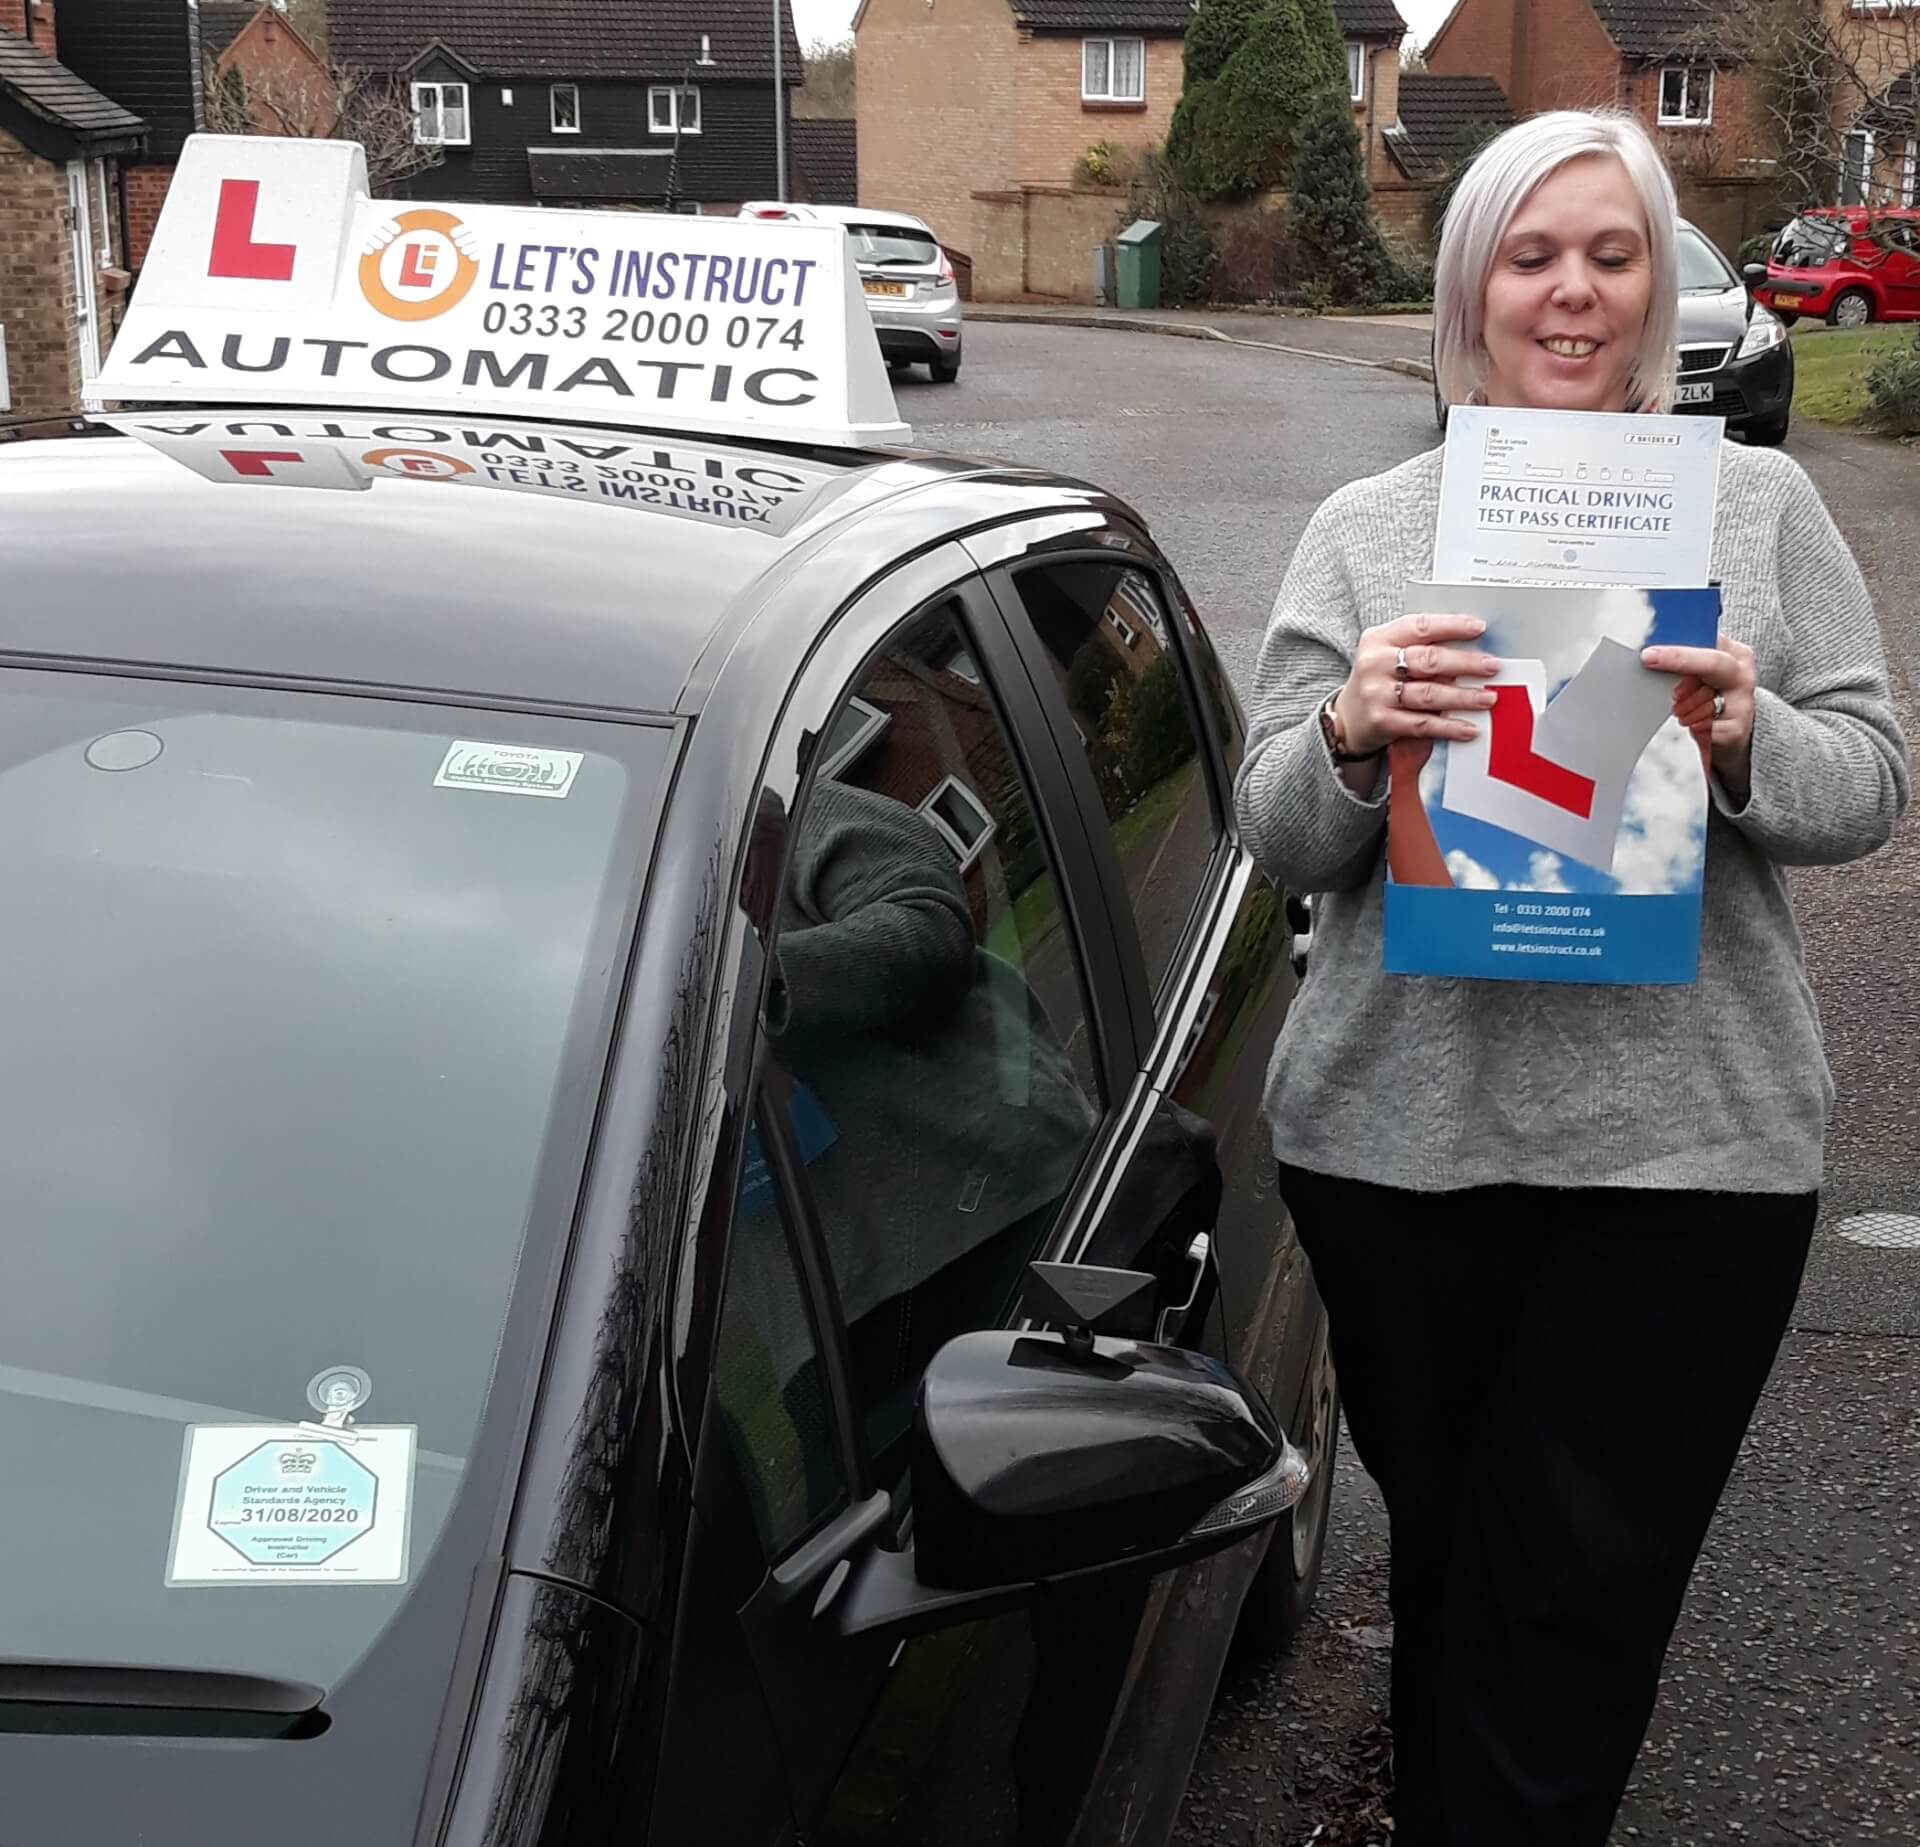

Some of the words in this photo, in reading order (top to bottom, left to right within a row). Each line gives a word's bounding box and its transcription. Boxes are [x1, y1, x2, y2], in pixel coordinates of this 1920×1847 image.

[208, 179, 297, 281] L
[489, 243, 600, 295] LET'S
[608, 249, 817, 307] INSTRUCT
[483, 301, 588, 339] 0333
[601, 308, 710, 346] 2000
[725, 315, 805, 351] 074
[128, 329, 820, 406] AUTOMATIC
[1680, 384, 1711, 401] ZLK
[1480, 485, 1580, 506] PRACTICAL
[1587, 490, 1673, 510] DRIVING
[1478, 508, 1515, 524] TEST
[1519, 510, 1559, 527] PASS
[1564, 513, 1672, 532] CERTIFICATE
[494, 750, 540, 761] TOYOTA
[1494, 903, 1508, 914] Tel
[1516, 904, 1543, 916] 0333
[1544, 906, 1570, 917] 2000
[1572, 907, 1592, 918] 074
[1492, 922, 1606, 937] info@letsinstruct.co.uk
[1491, 943, 1602, 957] www.letsinstruct.co.uk
[244, 1485, 279, 1494] Driver
[281, 1485, 303, 1494] and
[306, 1485, 348, 1494] Vehicle
[242, 1496, 300, 1505] Standards
[303, 1496, 346, 1506] Agency
[240, 1508, 359, 1523] 31/08/2020
[251, 1536, 294, 1544] Approved
[296, 1536, 328, 1544] Driving
[276, 1552, 299, 1560] (Car)
